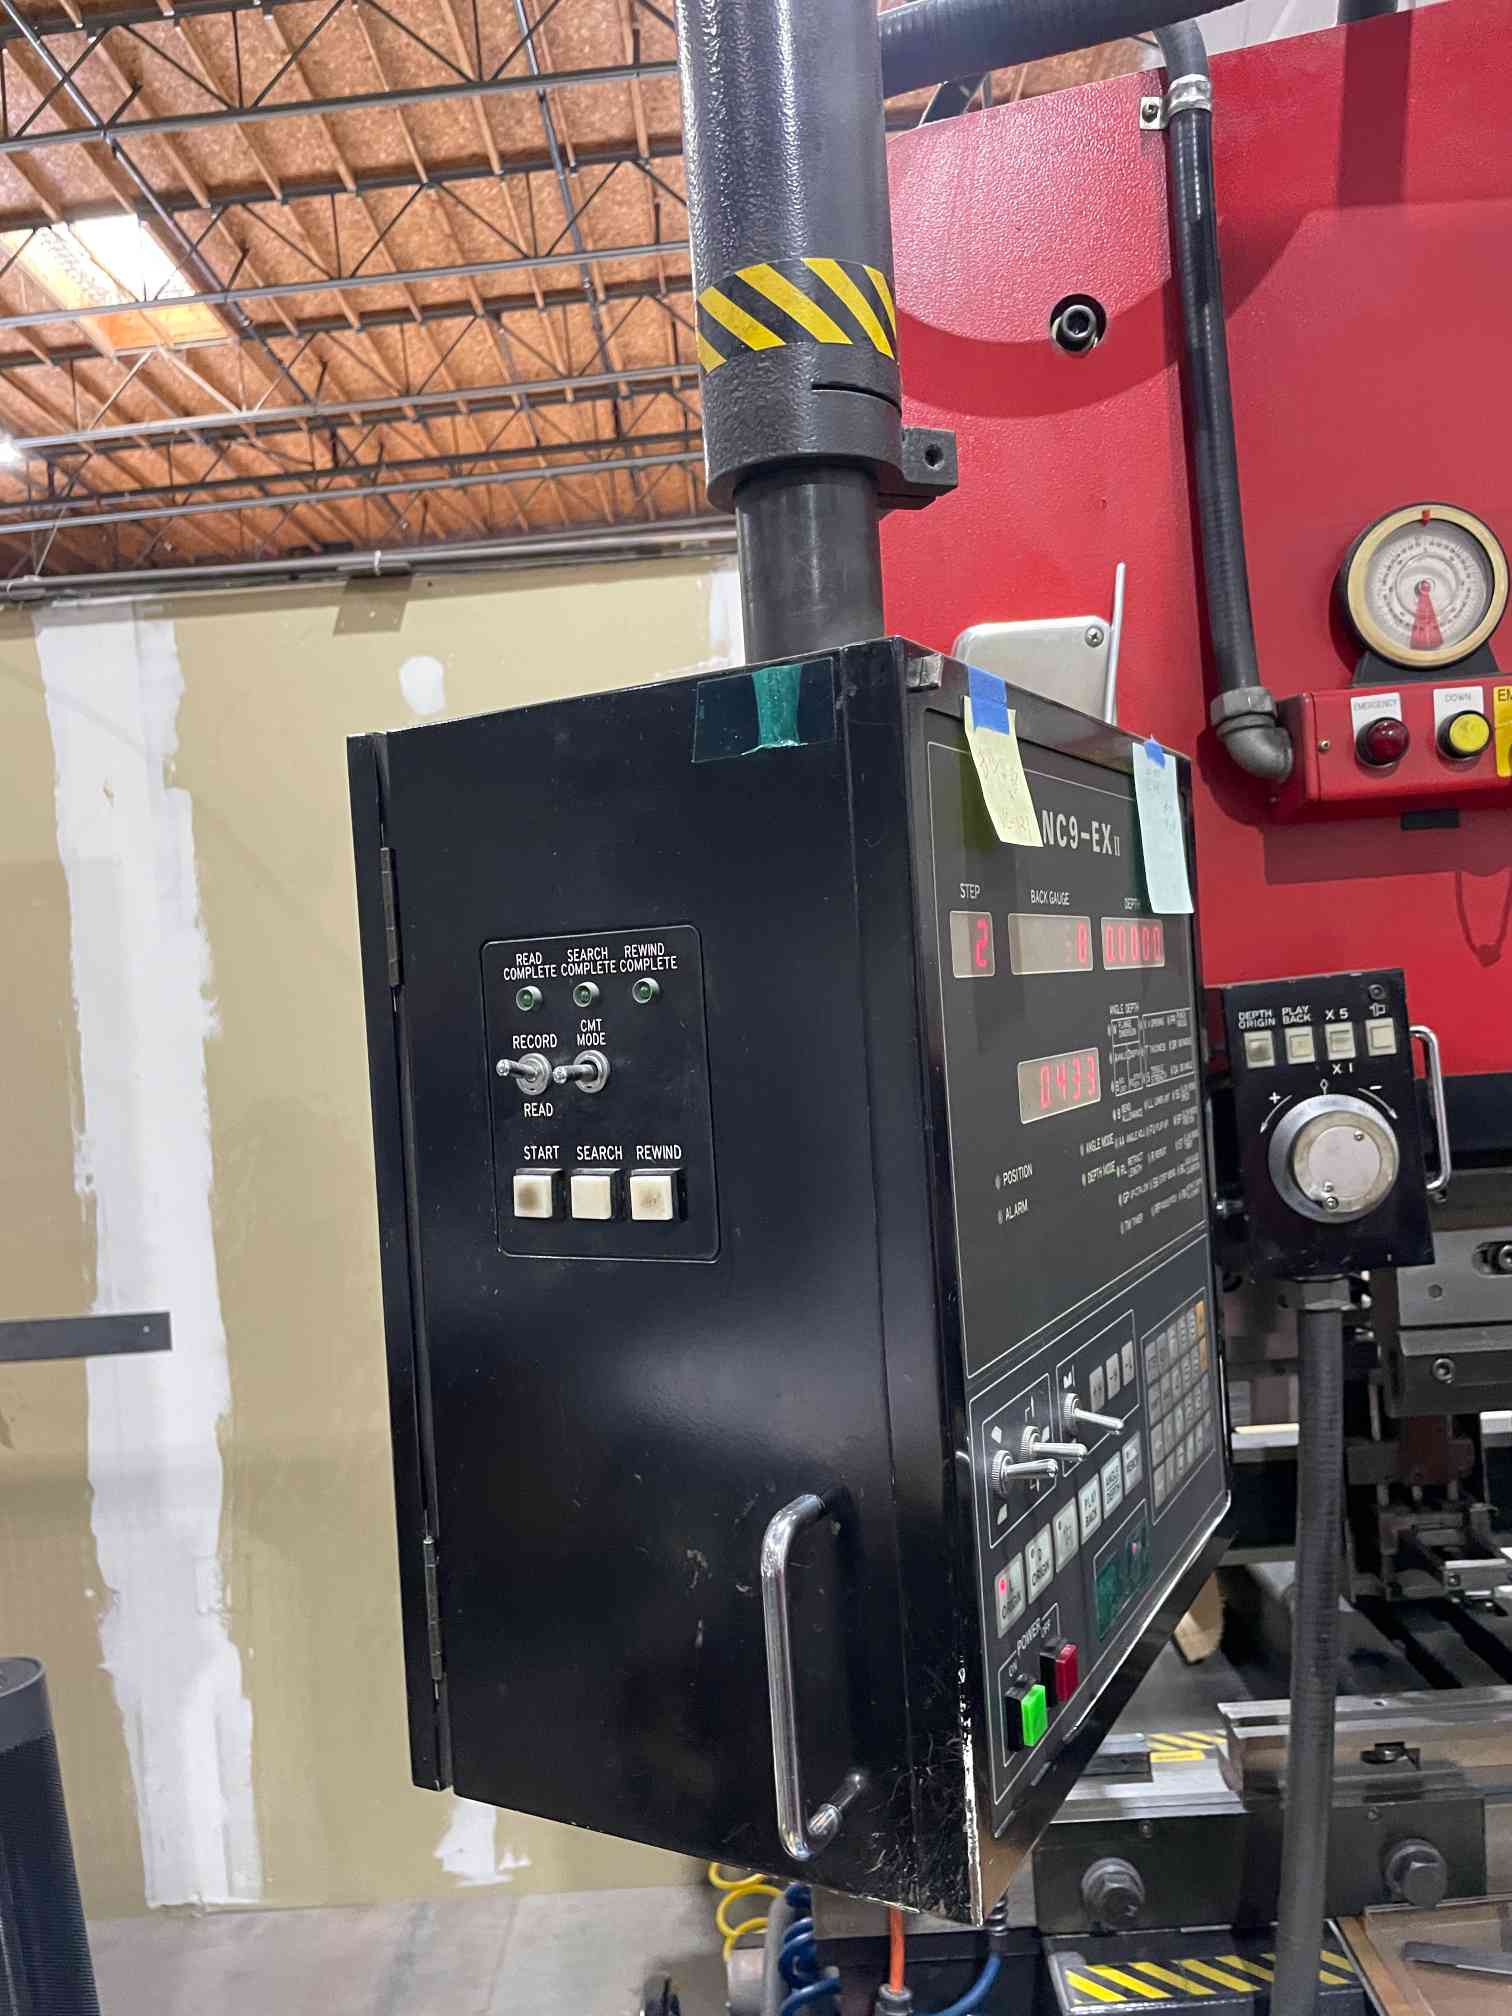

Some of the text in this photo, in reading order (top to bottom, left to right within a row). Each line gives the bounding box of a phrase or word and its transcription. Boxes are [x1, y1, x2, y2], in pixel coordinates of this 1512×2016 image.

[1444, 692, 1472, 702] DOWN
[959, 883, 981, 899] STEP
[1030, 889, 1070, 906] BACK GAUGE
[624, 942, 665, 958] REWIND
[976, 918, 989, 967] 2
[515, 952, 543, 966] READ
[566, 946, 609, 962] SEARCH
[503, 964, 557, 981] COMPLETE
[560, 960, 617, 977] COMPLETE
[619, 956, 678, 973] COMPLETE
[1238, 1010, 1272, 1020] DEPTH
[1282, 1005, 1309, 1015] PLAY
[580, 1018, 602, 1033] CMT
[1238, 1018, 1275, 1029] ORIGIN
[1282, 1014, 1311, 1024] BACK
[512, 1034, 558, 1049] RECORD
[576, 1032, 606, 1047] MODE
[523, 1102, 554, 1117] READ
[523, 1145, 559, 1160] START
[576, 1145, 623, 1160] SEARCH
[636, 1144, 682, 1160] REWIND
[1002, 1163, 1033, 1186] POSITION
[1005, 1199, 1029, 1221] ALARM
[1016, 1617, 1041, 1656] POWER
[1008, 1659, 1018, 1677] ON
